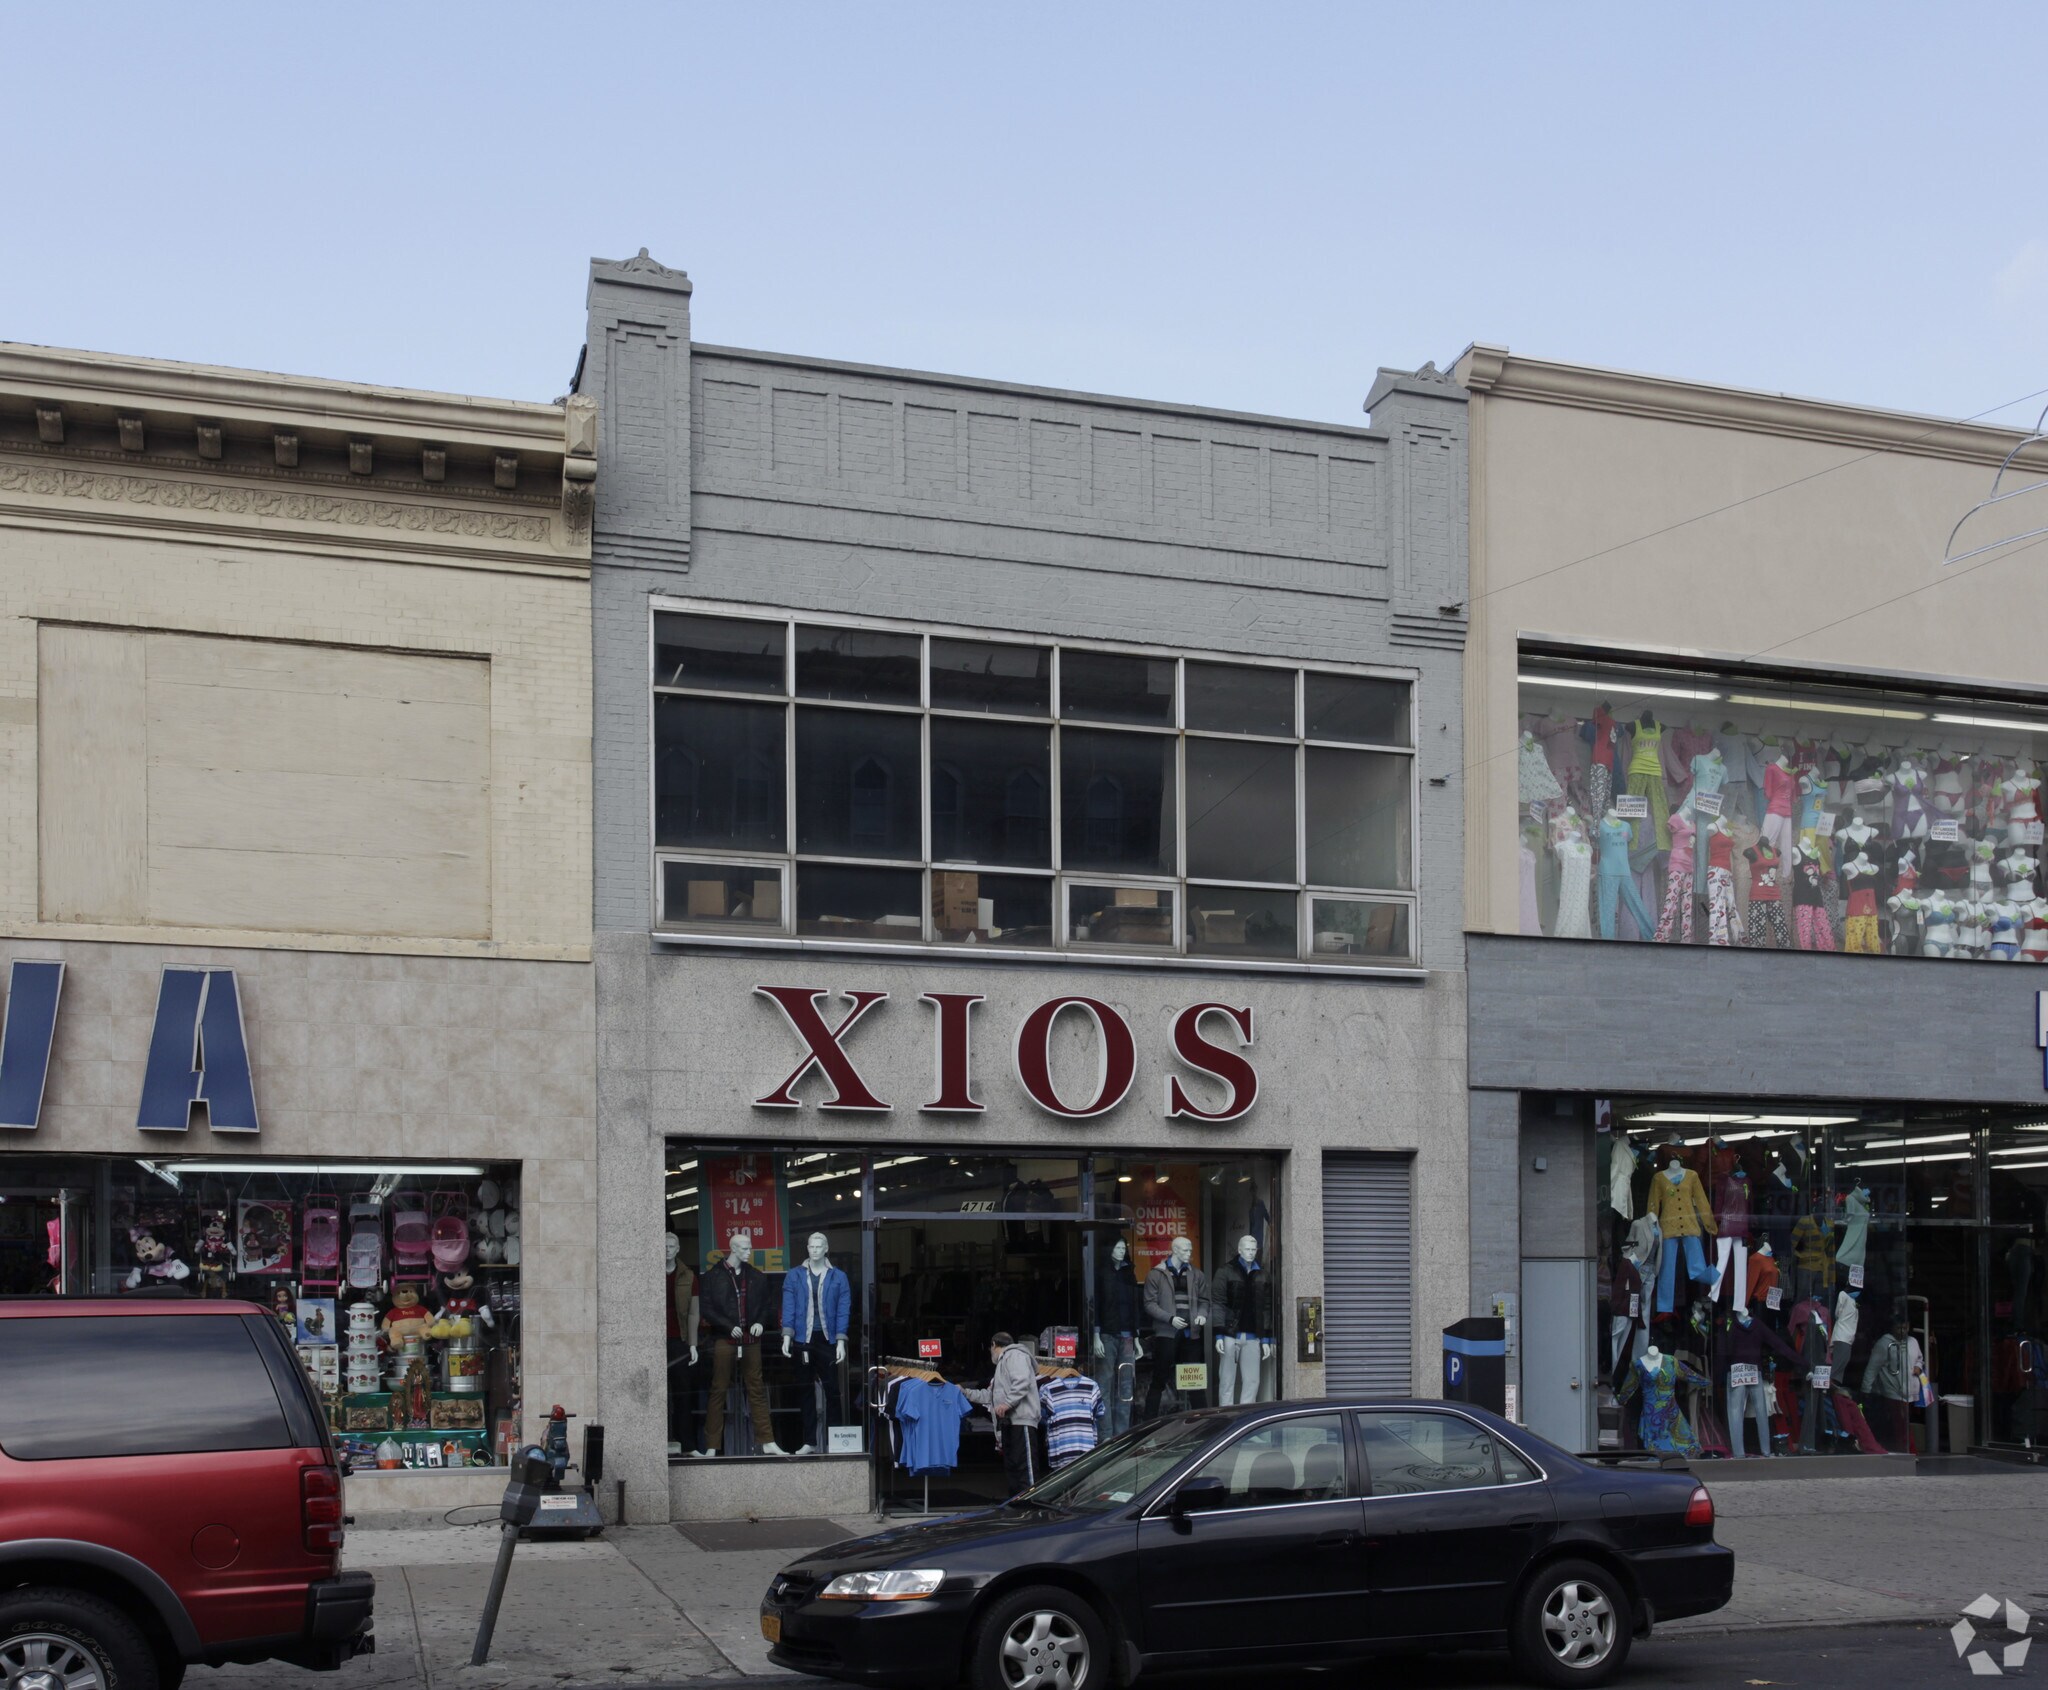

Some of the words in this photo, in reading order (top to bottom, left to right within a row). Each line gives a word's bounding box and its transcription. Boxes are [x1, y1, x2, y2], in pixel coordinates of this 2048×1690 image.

[751, 985, 1259, 1121] XIOS
[961, 1202, 993, 1212] 4714
[1136, 1207, 1186, 1219] ONLINE
[1136, 1221, 1187, 1236] STORE
[706, 1250, 784, 1271] SLE
[921, 1344, 938, 1353] $6.99
[1057, 1345, 1073, 1354] $6.99
[1451, 1357, 1460, 1381] P
[1733, 1376, 1757, 1386] SALE
